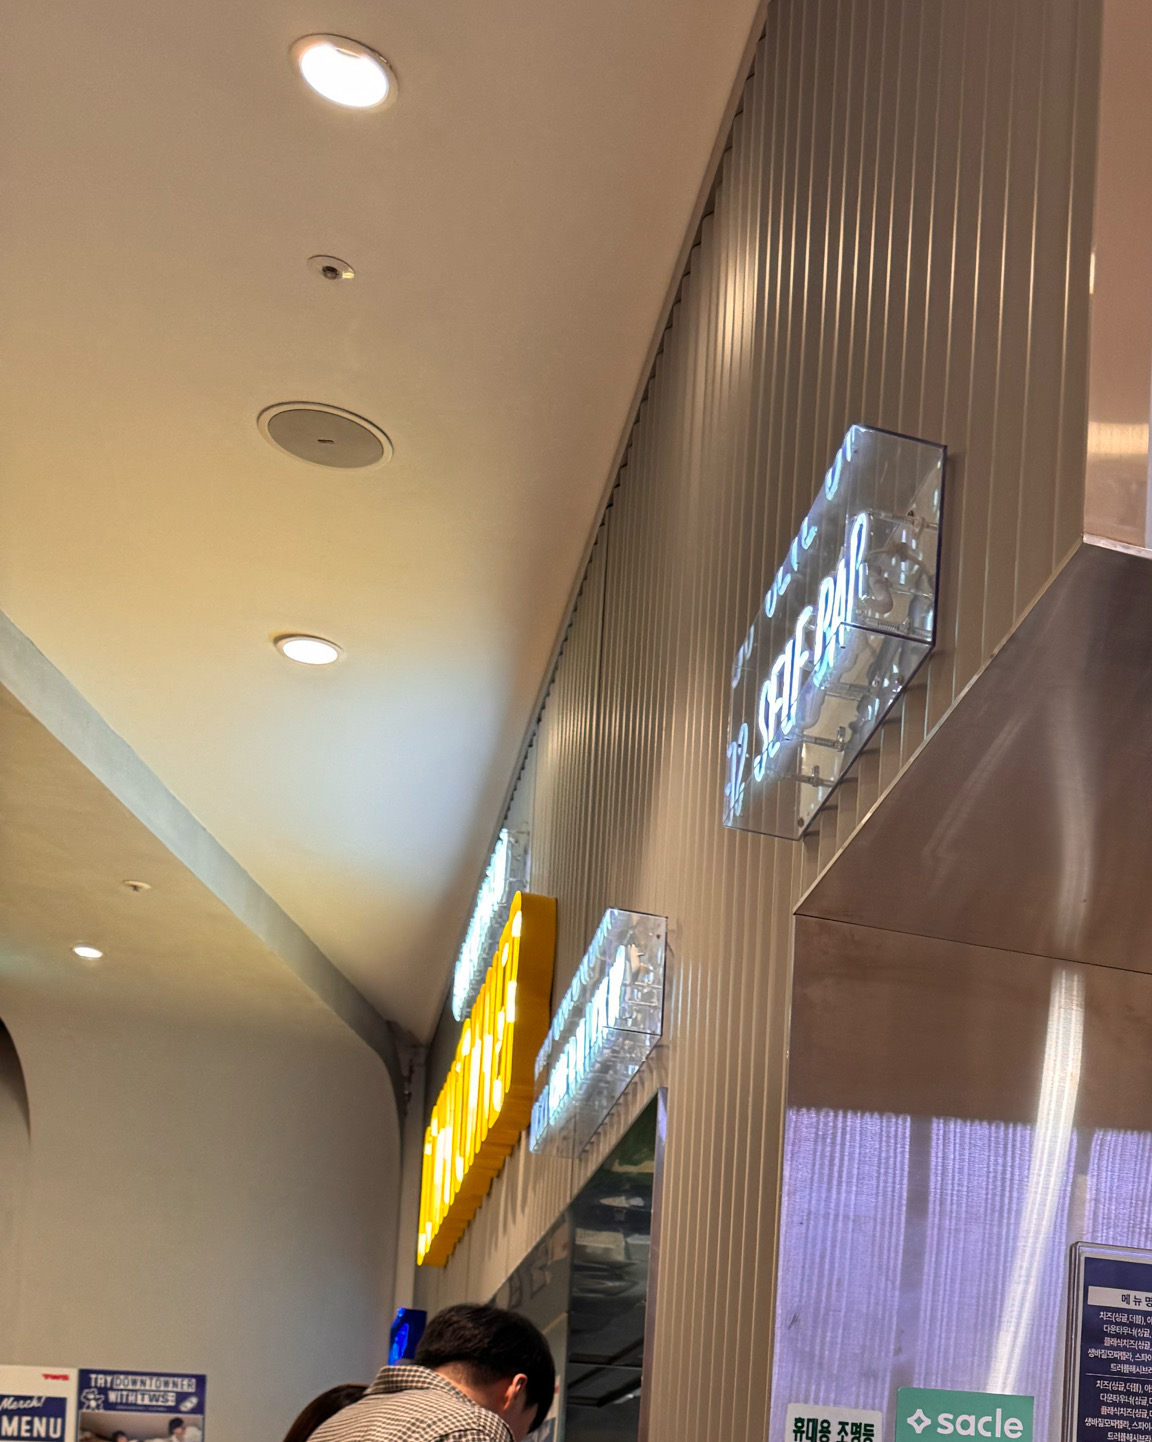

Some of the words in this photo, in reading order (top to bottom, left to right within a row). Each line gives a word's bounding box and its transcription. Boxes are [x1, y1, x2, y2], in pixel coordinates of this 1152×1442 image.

[90, 1374, 112, 1387] TRY
[108, 1390, 137, 1403] WITH
[1, 1415, 62, 1438] MENU
[937, 1408, 1023, 1438] sacle
